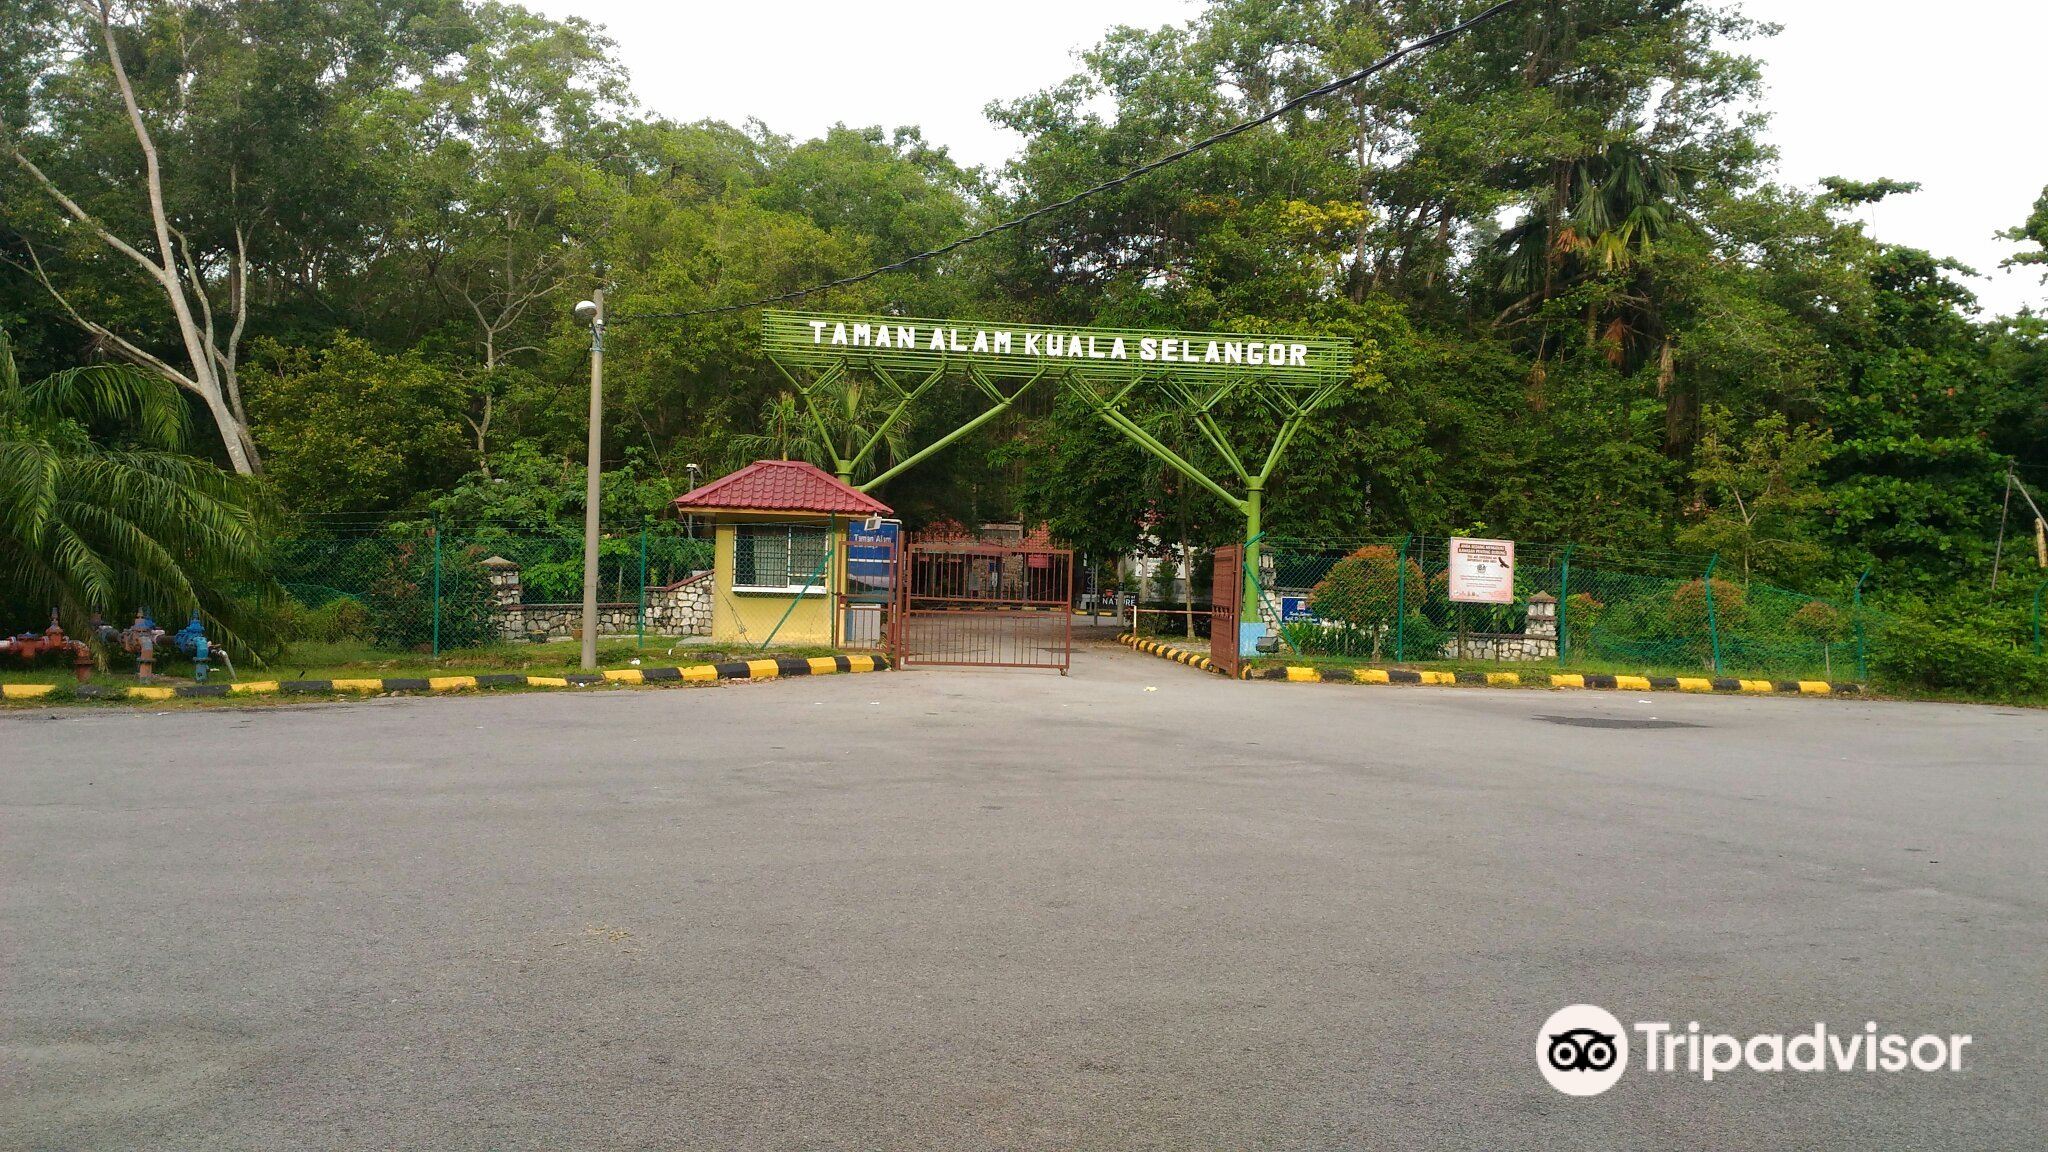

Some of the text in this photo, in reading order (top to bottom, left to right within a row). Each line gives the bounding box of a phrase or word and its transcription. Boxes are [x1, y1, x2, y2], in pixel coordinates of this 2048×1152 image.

[808, 320, 1307, 367] TAMAN ALAM KUALA SELANGOR
[1102, 598, 1136, 606] NATRE
